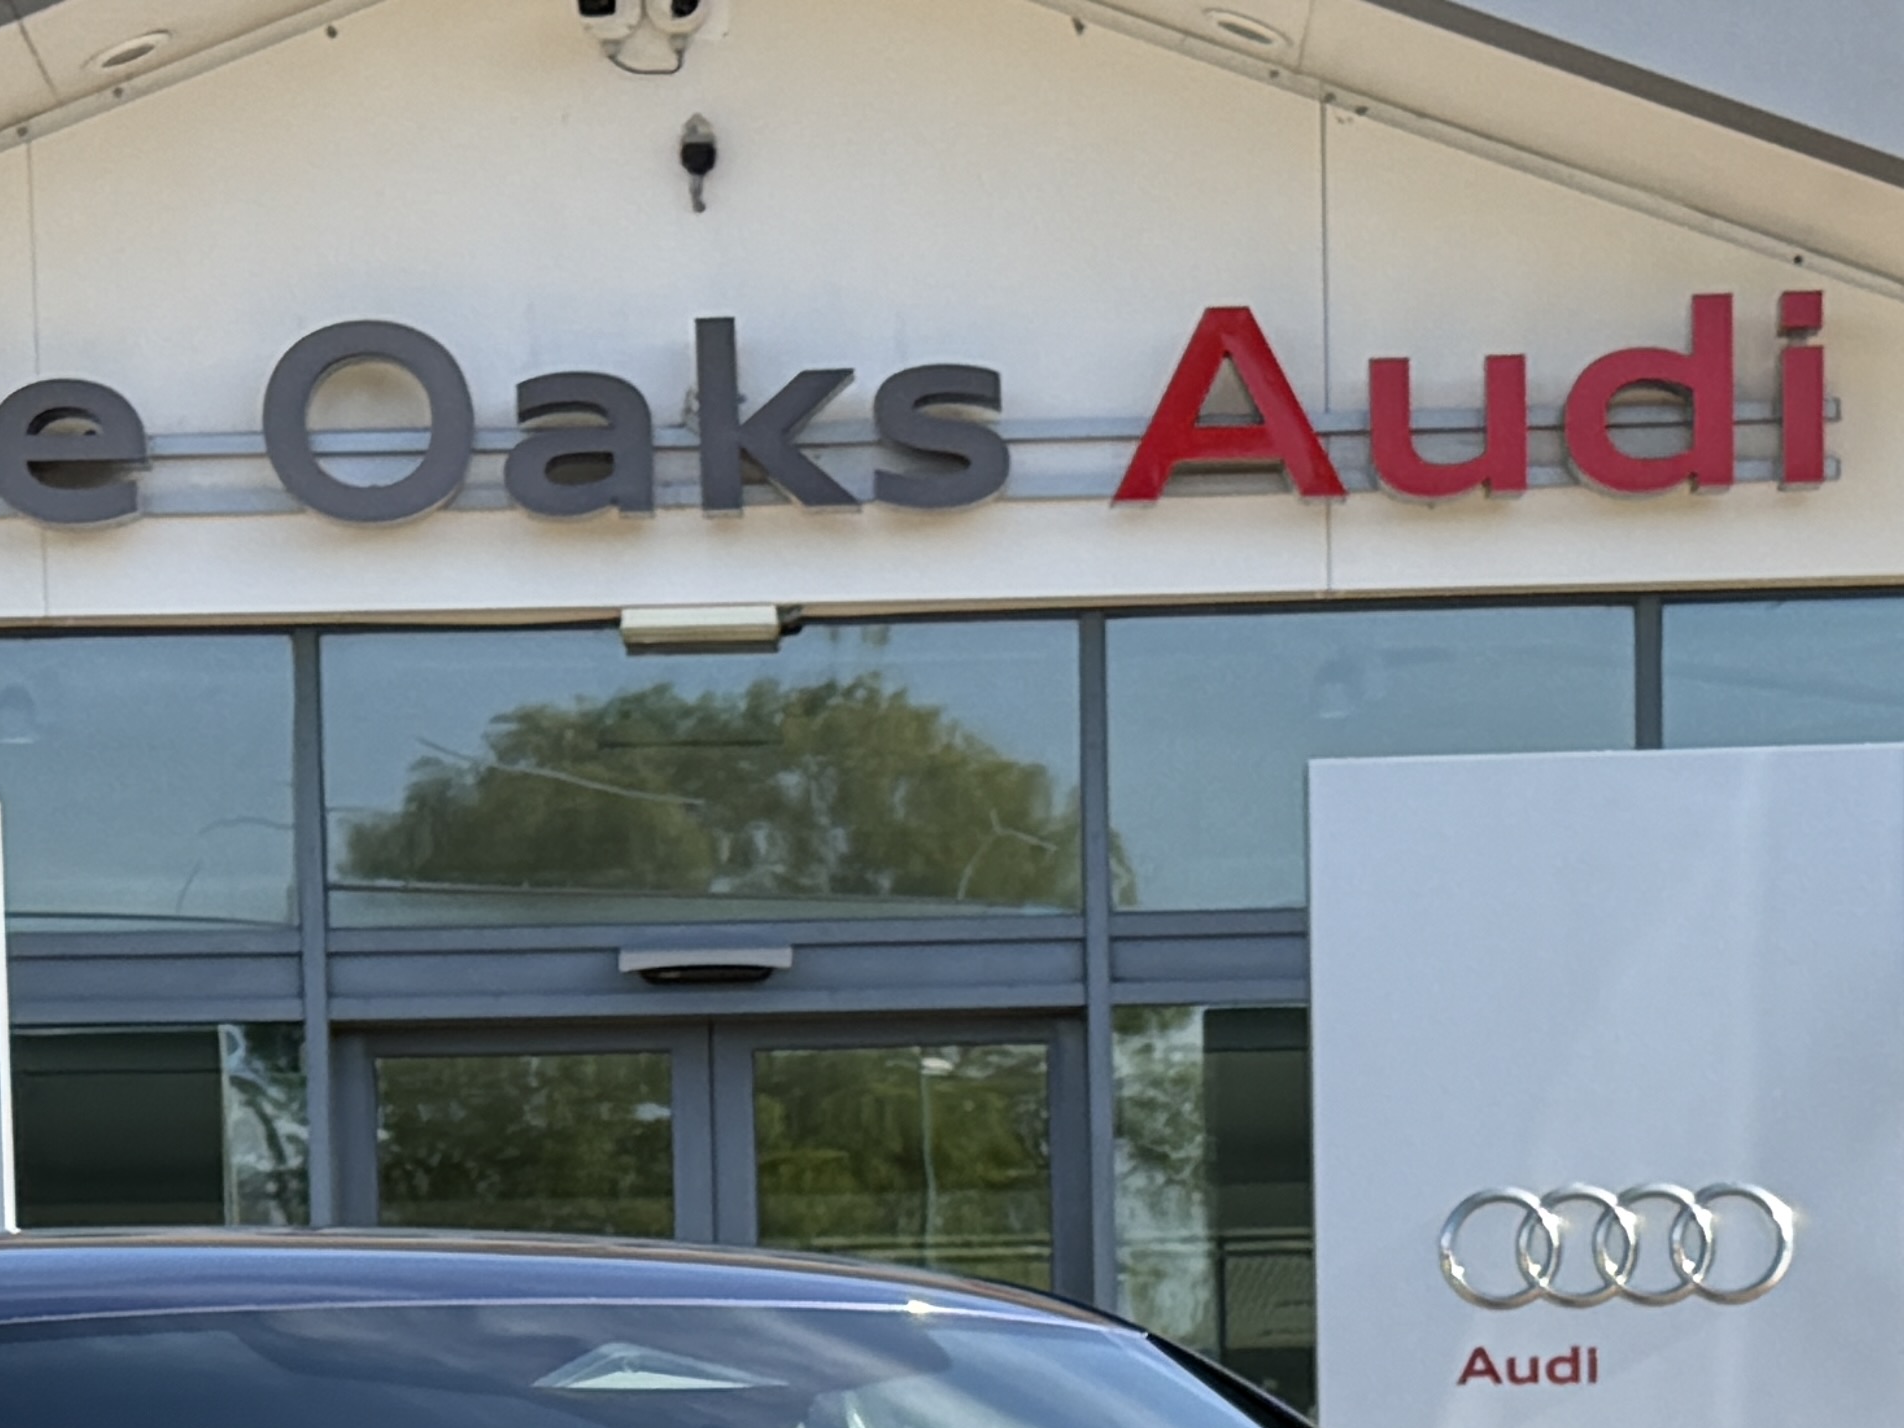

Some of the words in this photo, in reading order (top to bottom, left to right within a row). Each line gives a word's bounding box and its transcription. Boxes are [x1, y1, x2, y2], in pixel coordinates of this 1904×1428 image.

[263, 317, 1011, 526] Oaks
[1110, 290, 1825, 507] Audi
[1456, 1345, 1598, 1385] Audi
